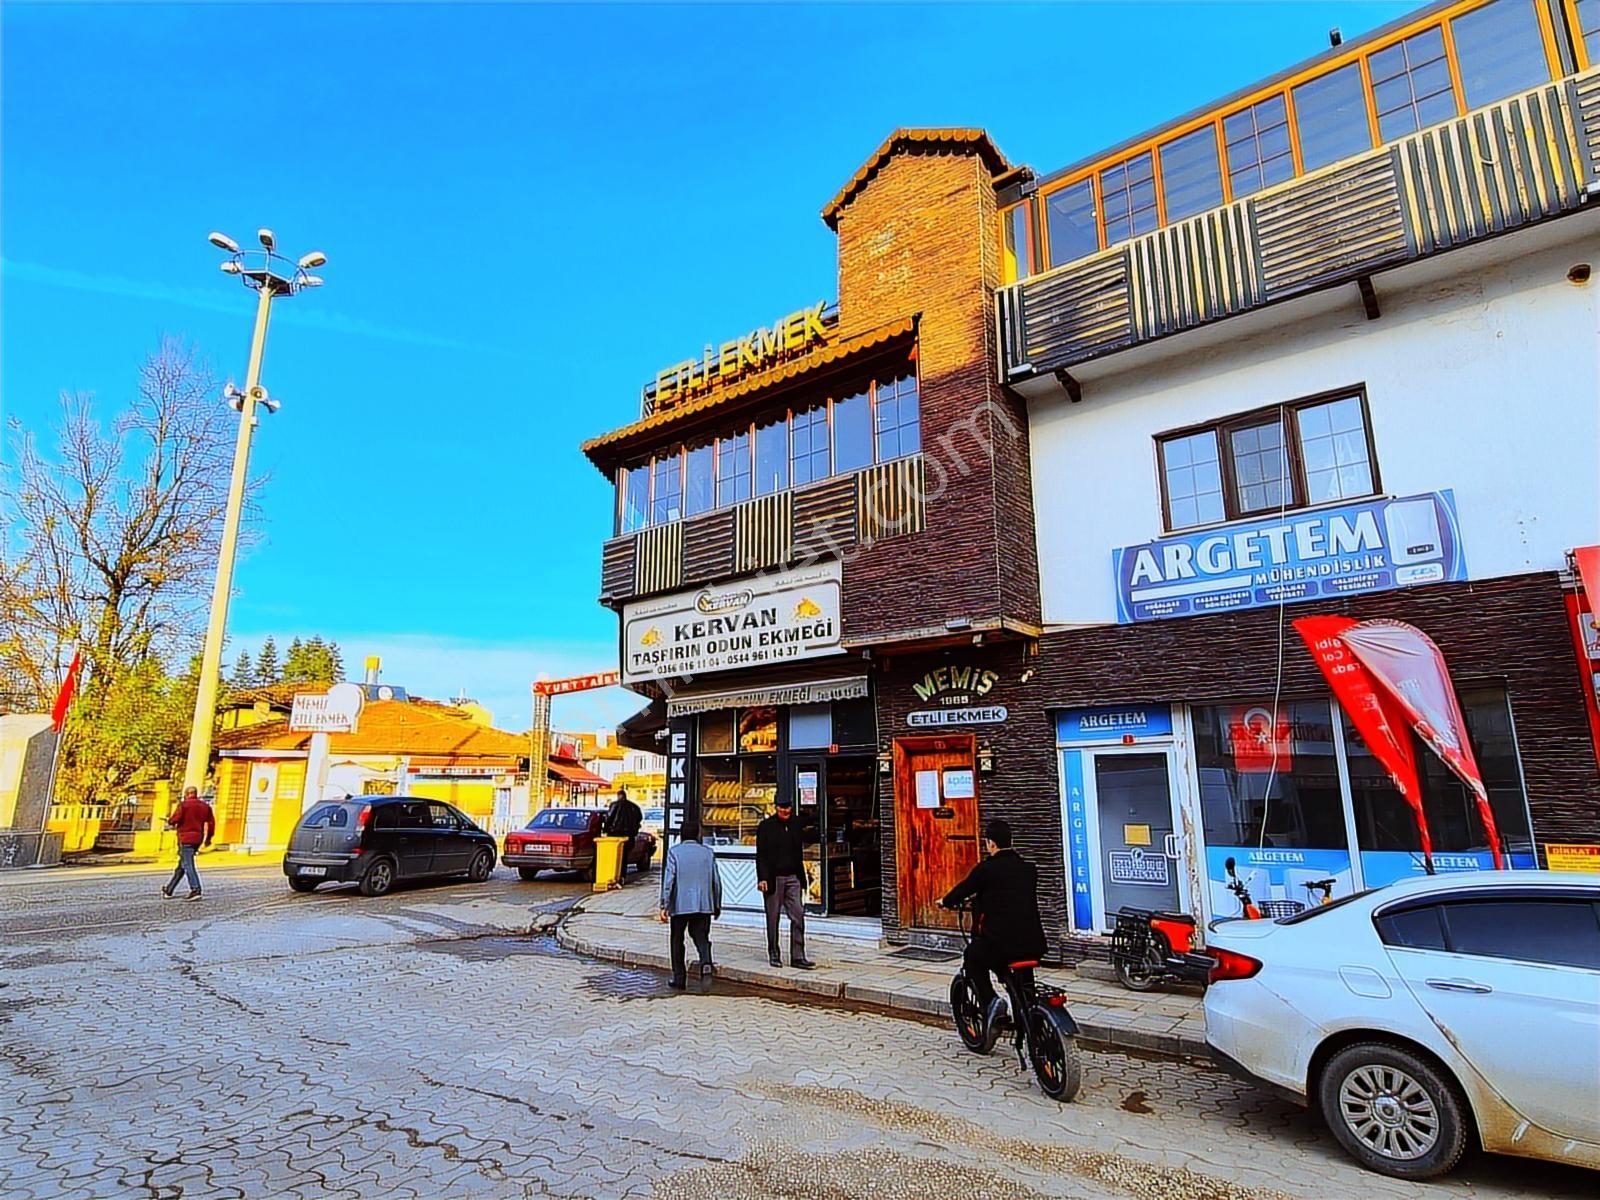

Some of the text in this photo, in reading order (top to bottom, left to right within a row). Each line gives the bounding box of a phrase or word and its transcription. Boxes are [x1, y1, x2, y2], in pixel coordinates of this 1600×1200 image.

[718, 299, 828, 377] EKMEK
[1131, 510, 1384, 586] ARGETEM
[1254, 555, 1386, 585] MÜHENDİSLİK
[673, 608, 778, 642] KERVAN
[706, 634, 753, 654] ODUN
[759, 618, 833, 647] EKMEĞİ
[752, 649, 769, 661] 961
[773, 648, 784, 658] 14
[786, 646, 798, 657] 37
[946, 709, 1002, 723] EKMEK
[1080, 712, 1147, 728] ARGETEM
[1071, 787, 1088, 894] ARGETEM
[1552, 846, 1590, 855] DİKKAT
[1411, 856, 1479, 868] AGETEM
